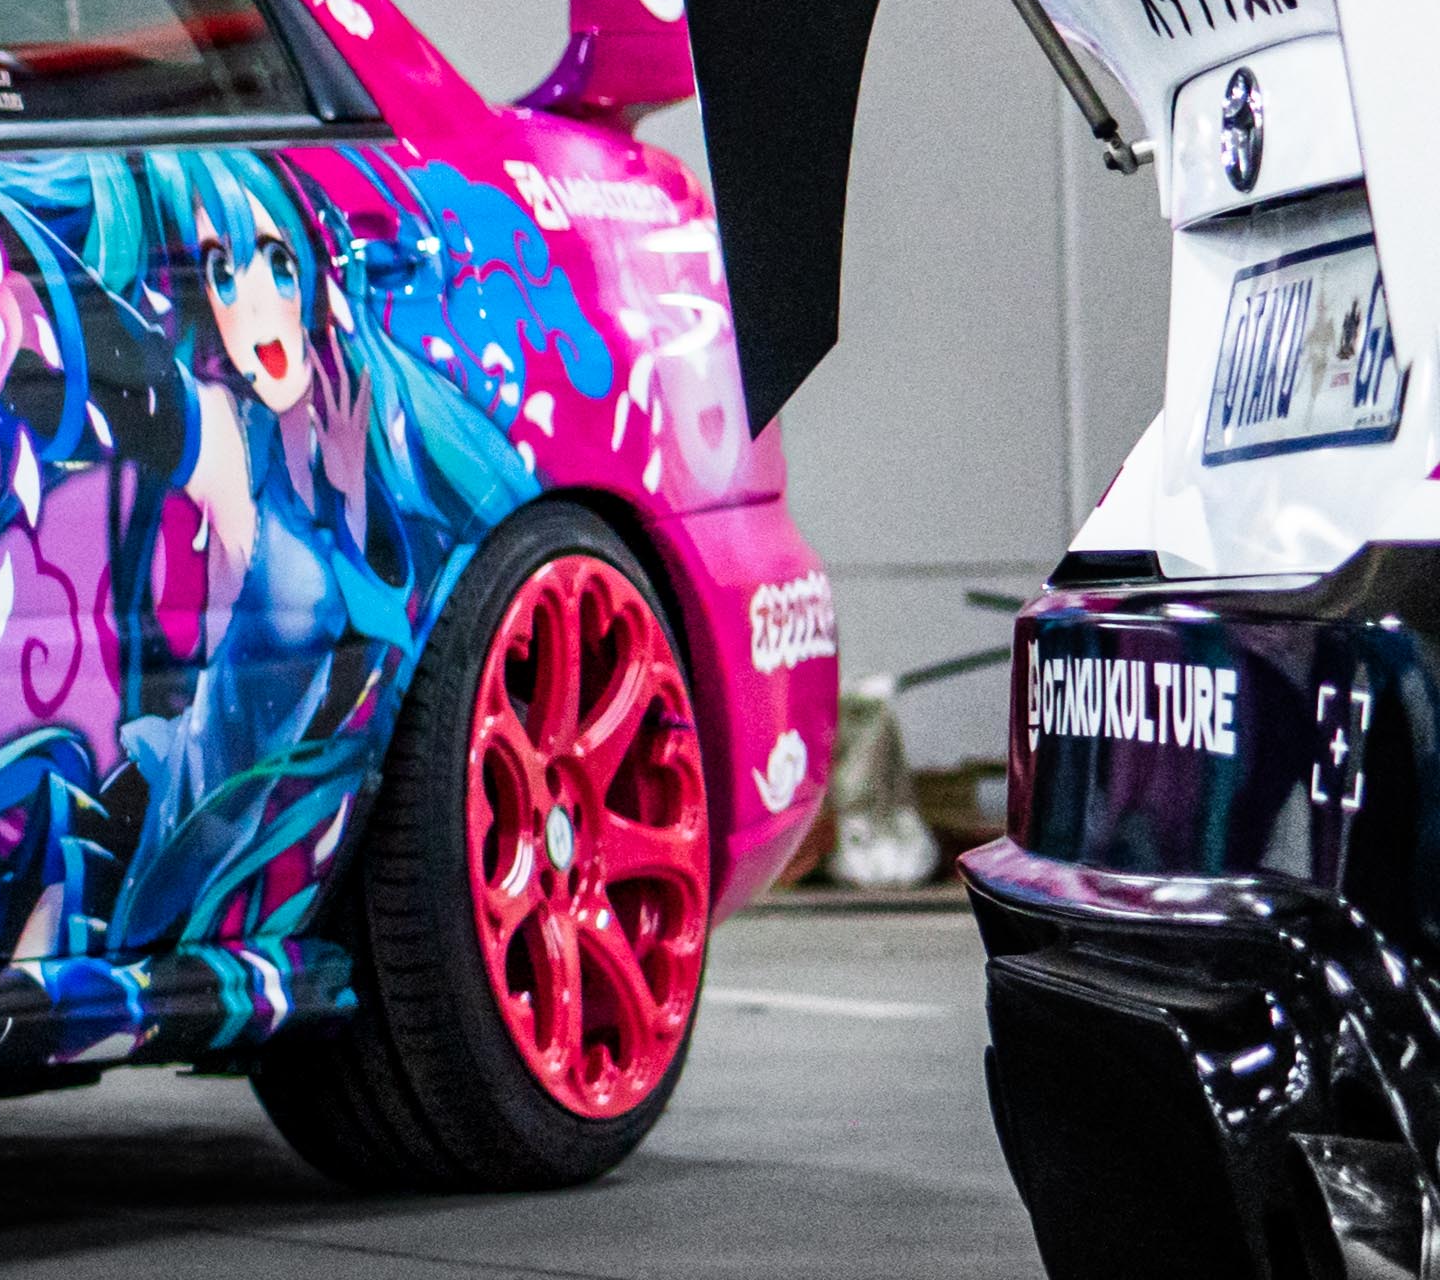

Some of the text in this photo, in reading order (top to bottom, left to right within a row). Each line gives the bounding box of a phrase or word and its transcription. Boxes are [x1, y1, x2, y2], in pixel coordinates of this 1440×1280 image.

[1221, 278, 1313, 431] OTAKU
[1043, 654, 1237, 756] OTAKU KULTURE
